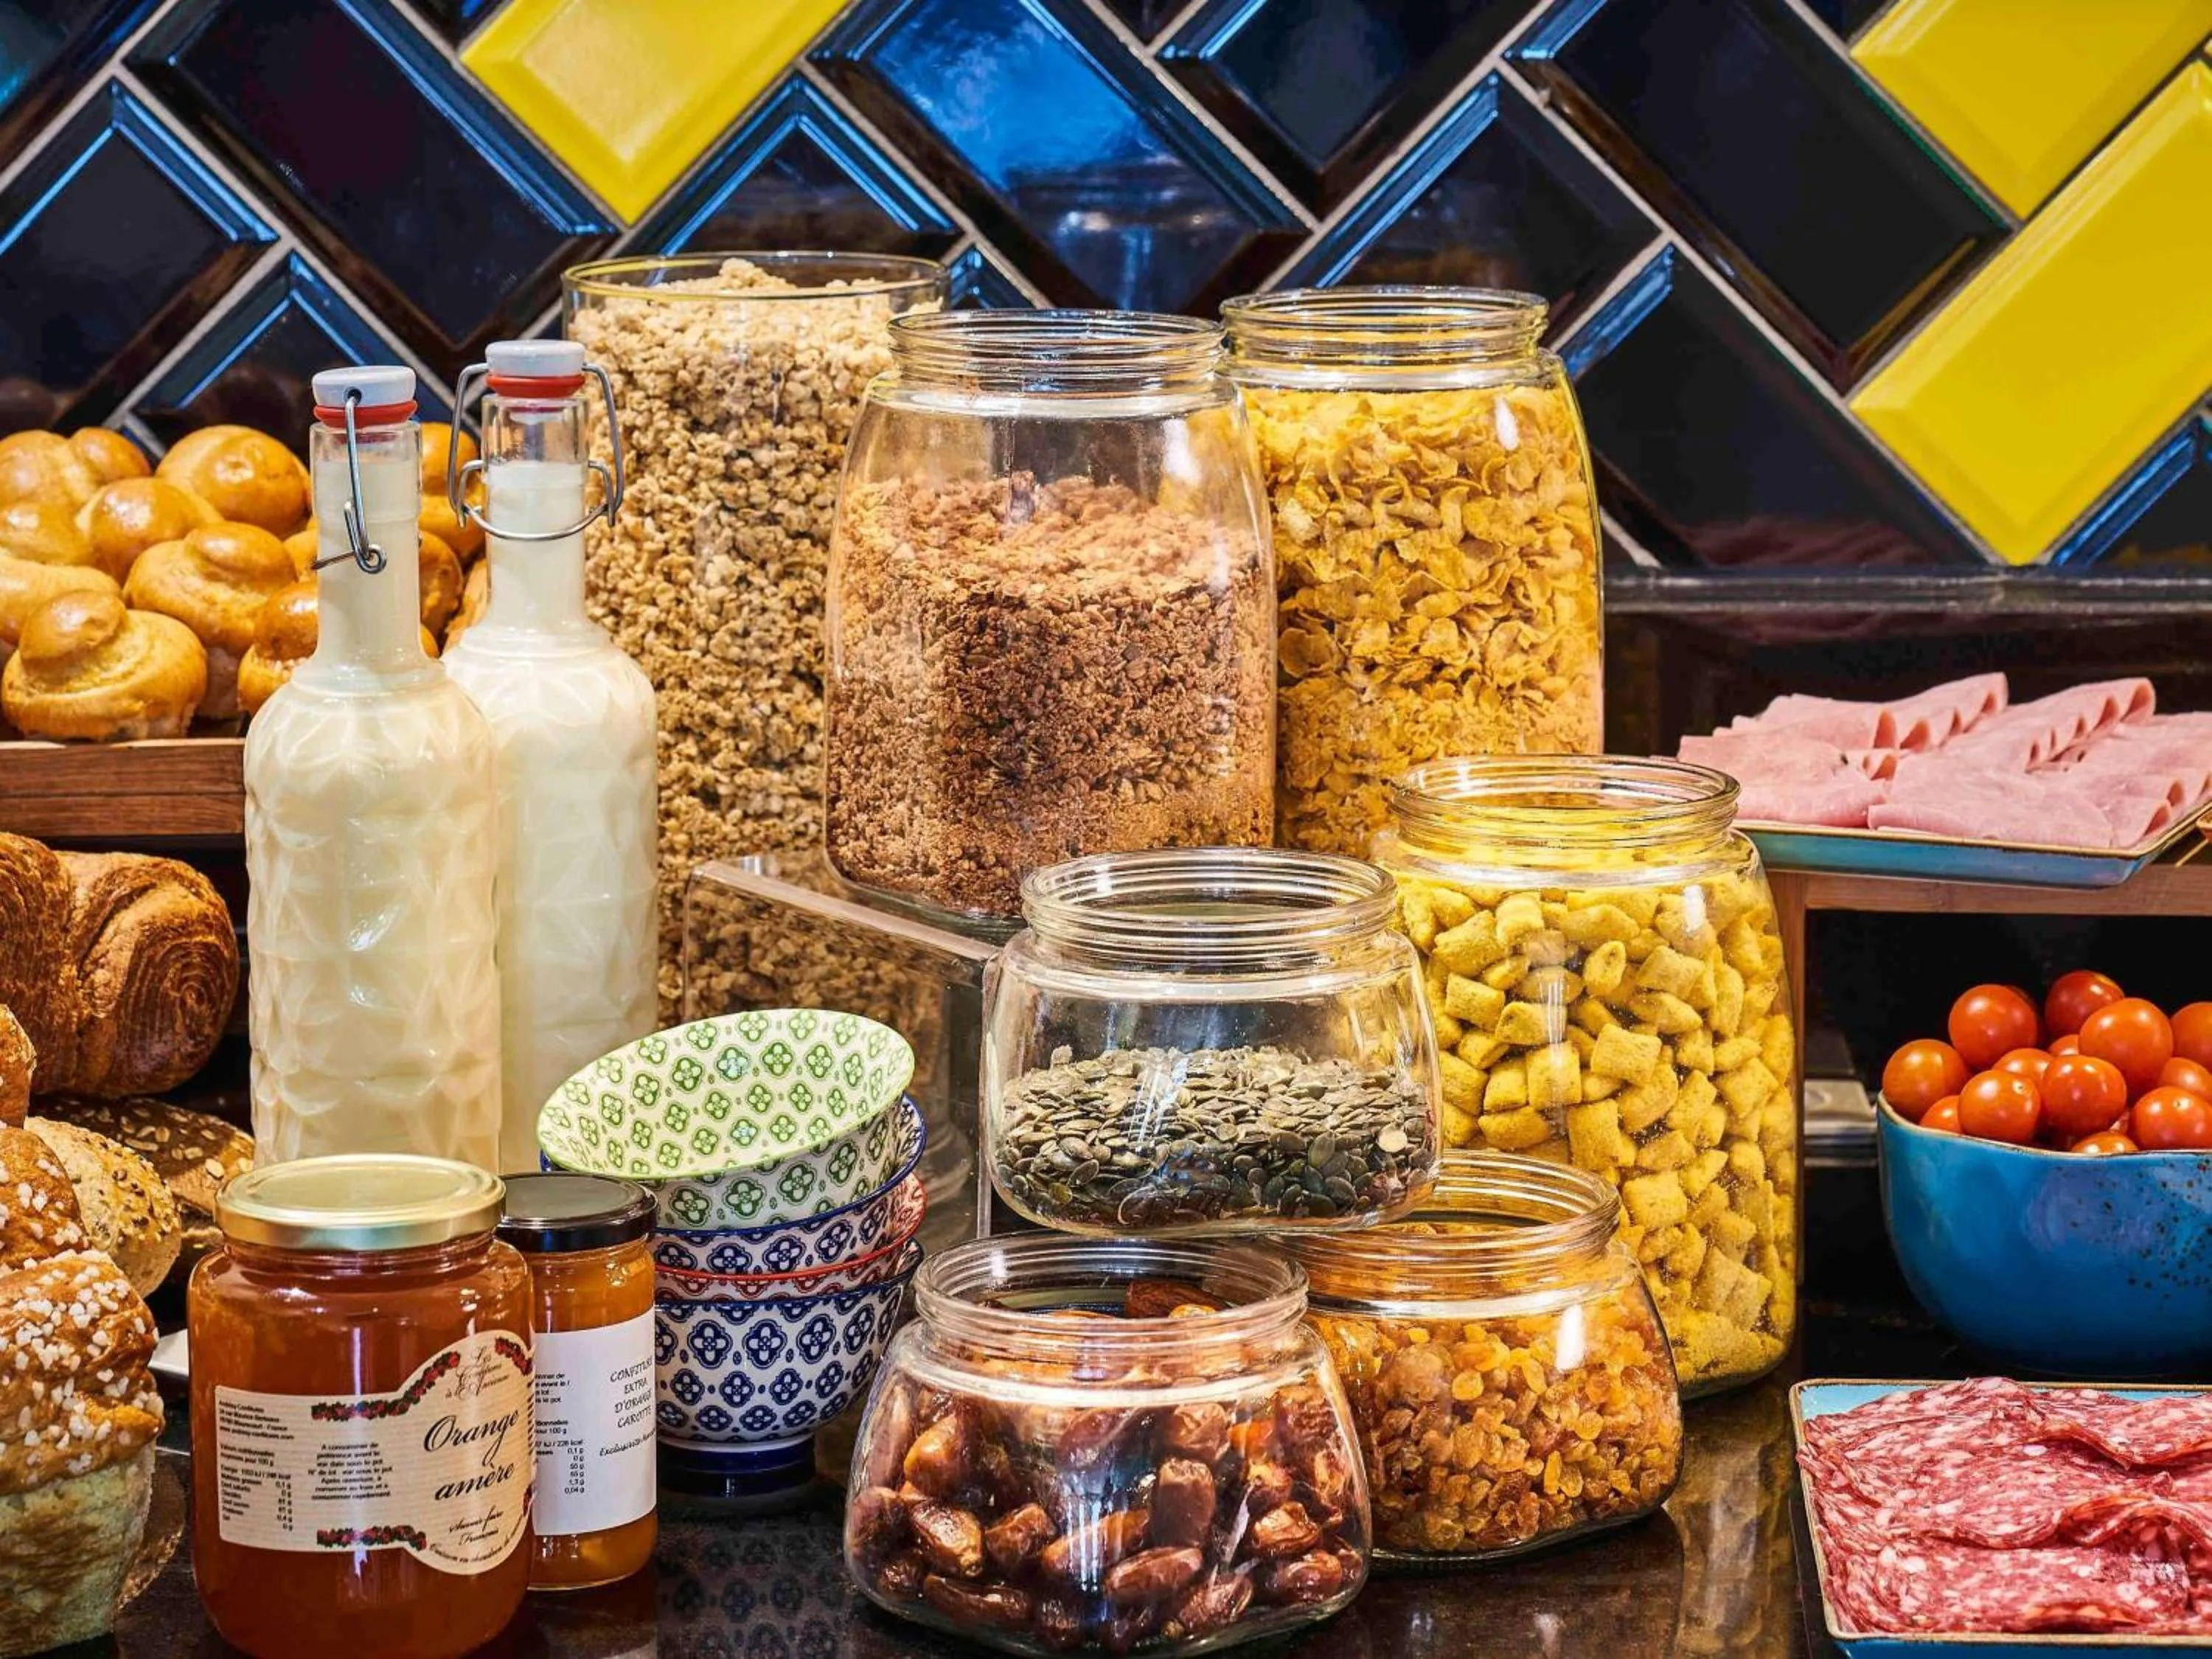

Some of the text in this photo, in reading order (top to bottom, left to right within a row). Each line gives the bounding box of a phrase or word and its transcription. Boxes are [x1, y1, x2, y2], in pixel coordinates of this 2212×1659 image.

[624, 1377, 648, 1394] EXTRA
[423, 1408, 519, 1467] Orange
[435, 1462, 515, 1501] amère
